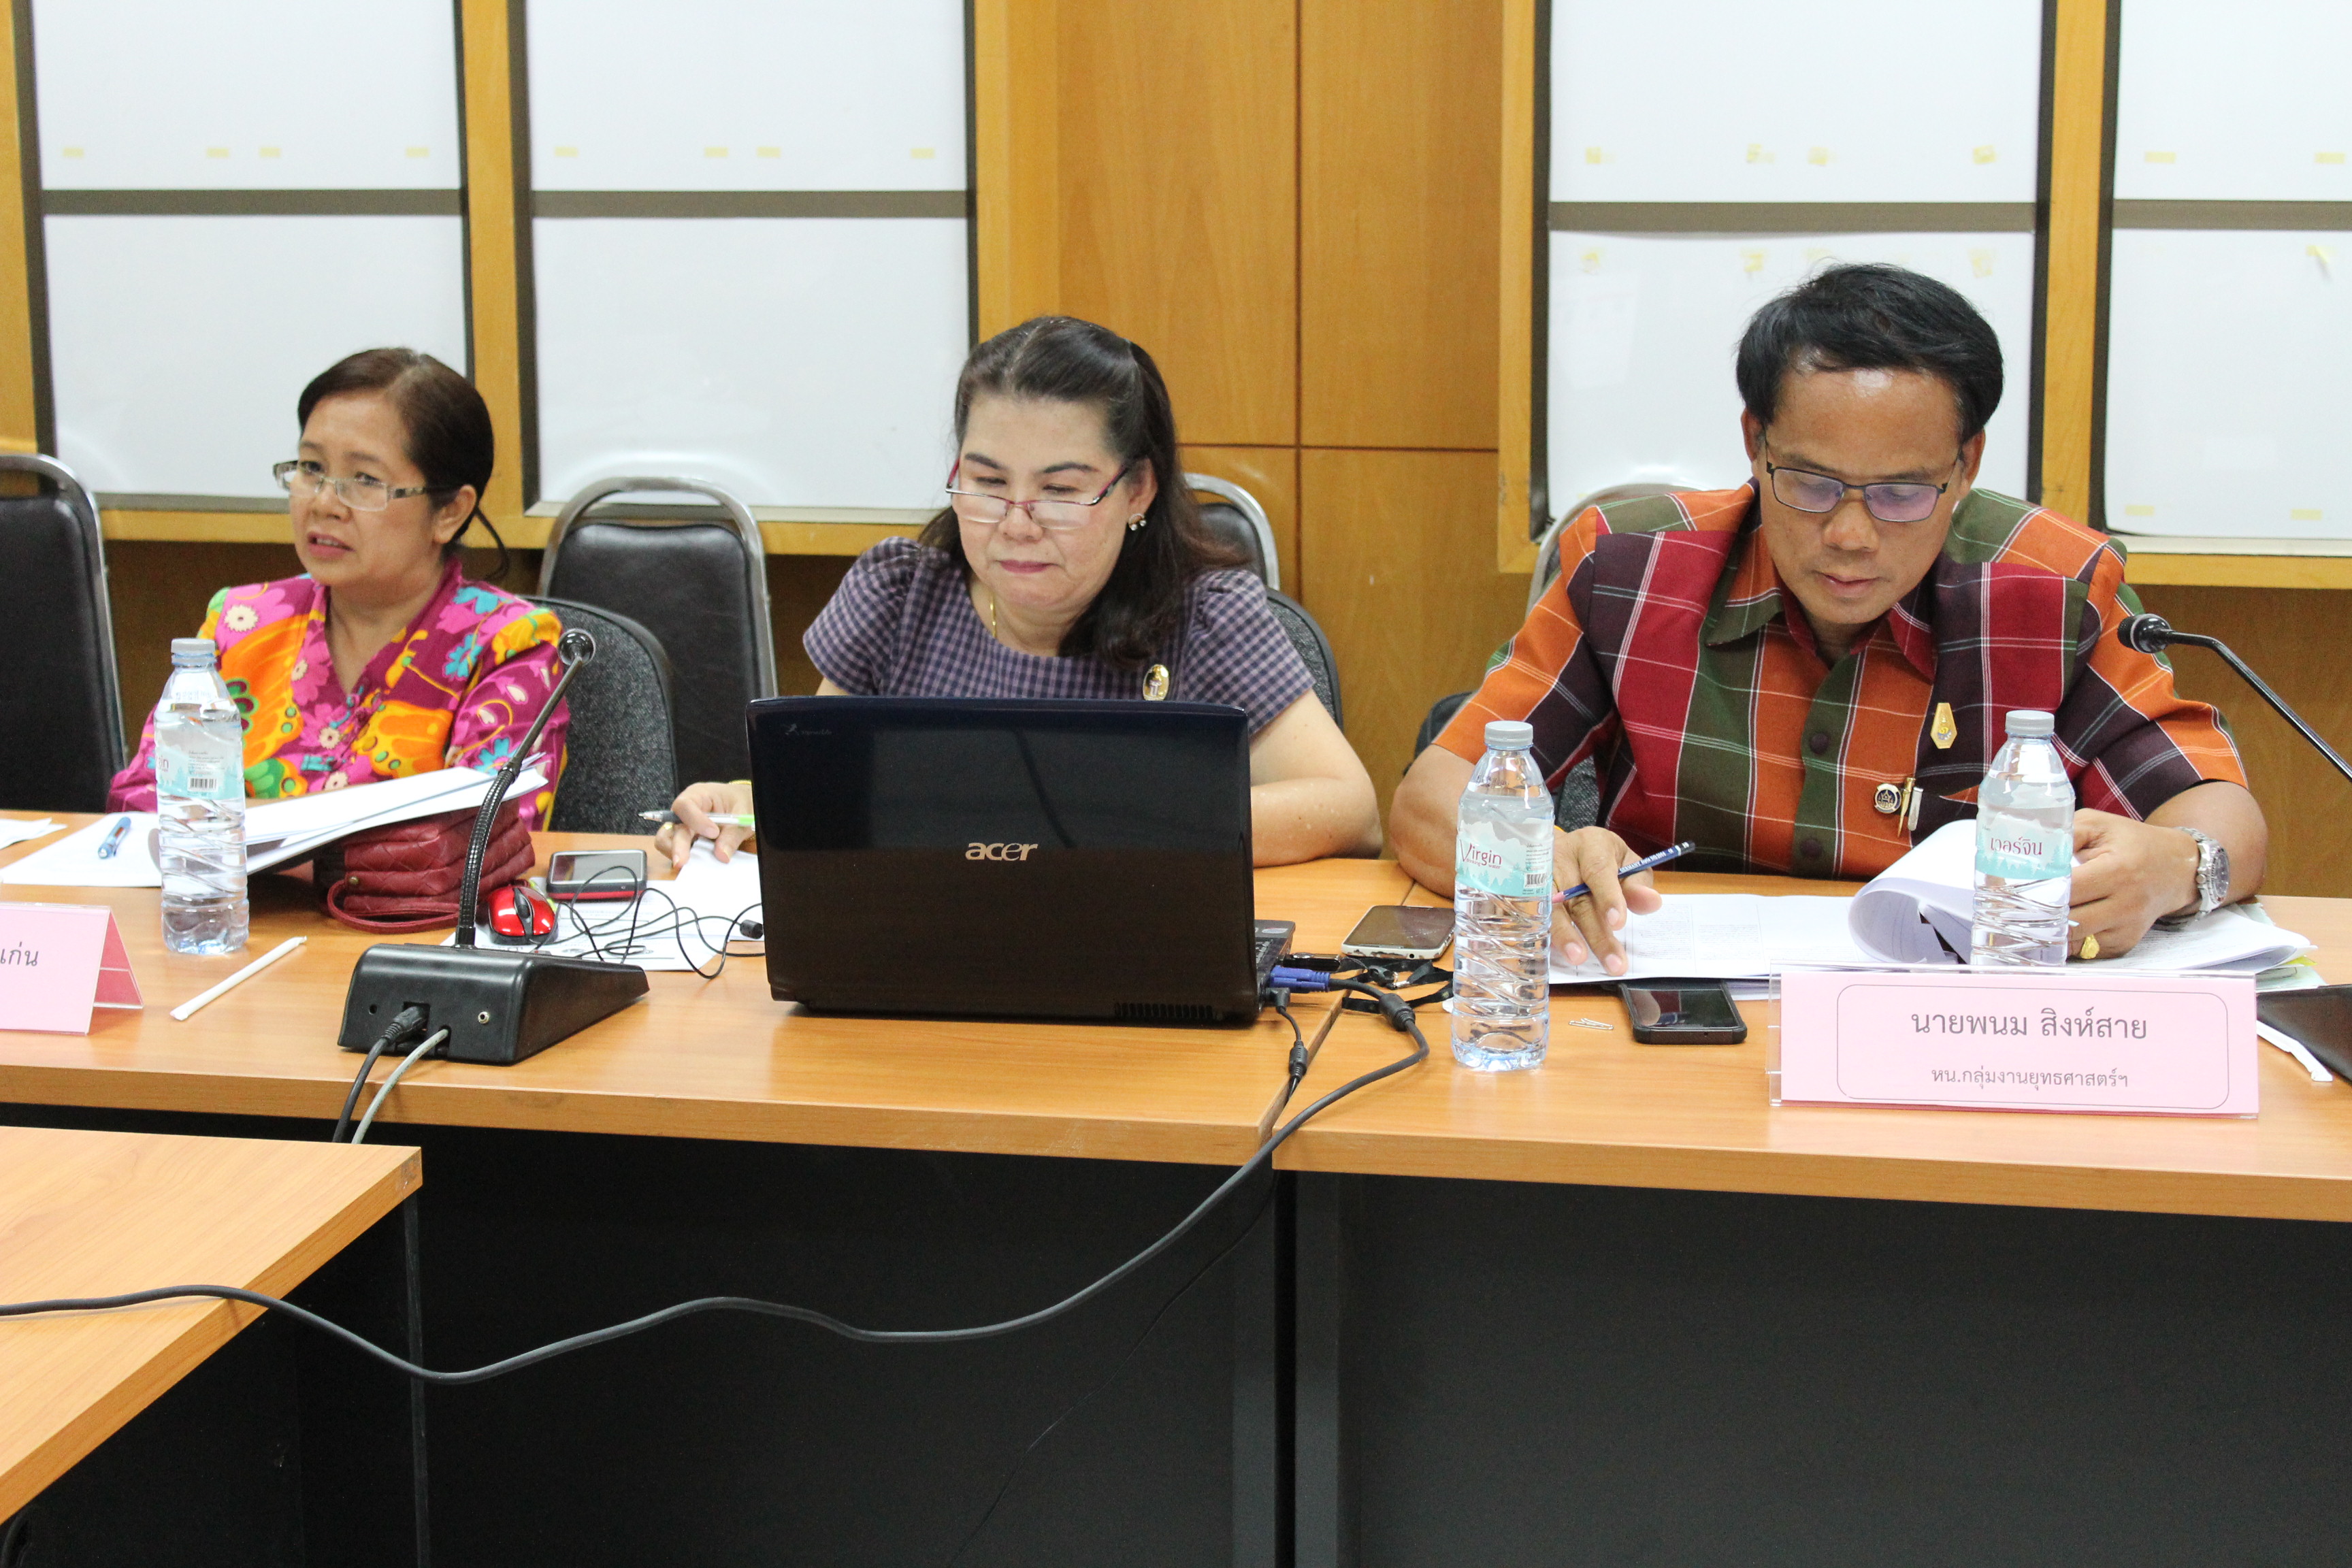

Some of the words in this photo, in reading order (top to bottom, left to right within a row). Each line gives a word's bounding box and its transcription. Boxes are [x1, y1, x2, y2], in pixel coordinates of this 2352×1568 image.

[965, 842, 1039, 861] acer
[1459, 838, 1502, 866] Virgin
[1990, 836, 2042, 855] เวอร์จิน
[1911, 1013, 2027, 1036] นายพนม
[2040, 1006, 2147, 1039] สิงห์สาย
[1931, 1065, 2129, 1091] หน.กลุ่มงานยุทธศาสตร์ฯ
